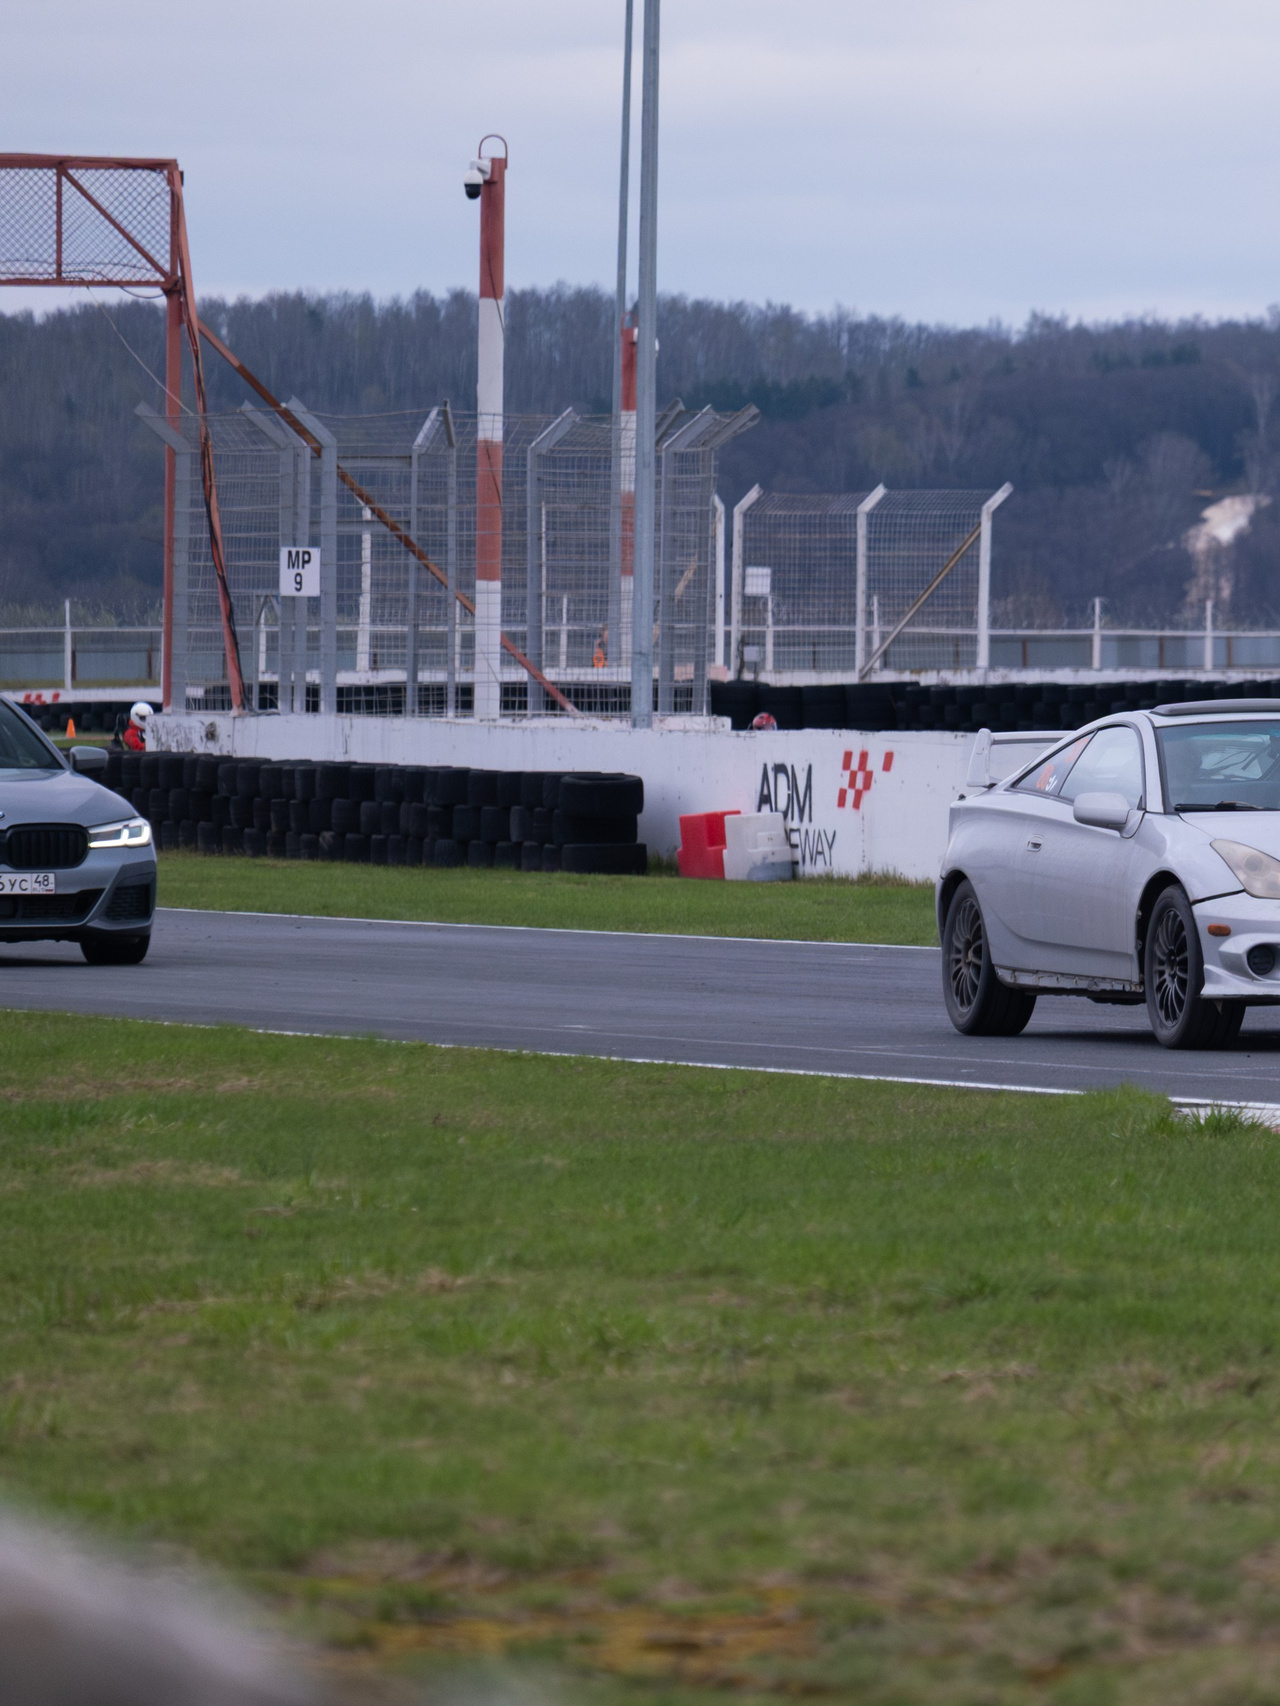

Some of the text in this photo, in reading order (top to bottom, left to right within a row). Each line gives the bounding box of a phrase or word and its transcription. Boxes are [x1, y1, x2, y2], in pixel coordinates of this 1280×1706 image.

[287, 550, 312, 570] MP
[294, 572, 303, 592] 9
[757, 763, 812, 823] ADM
[34, 874, 50, 887] 48
